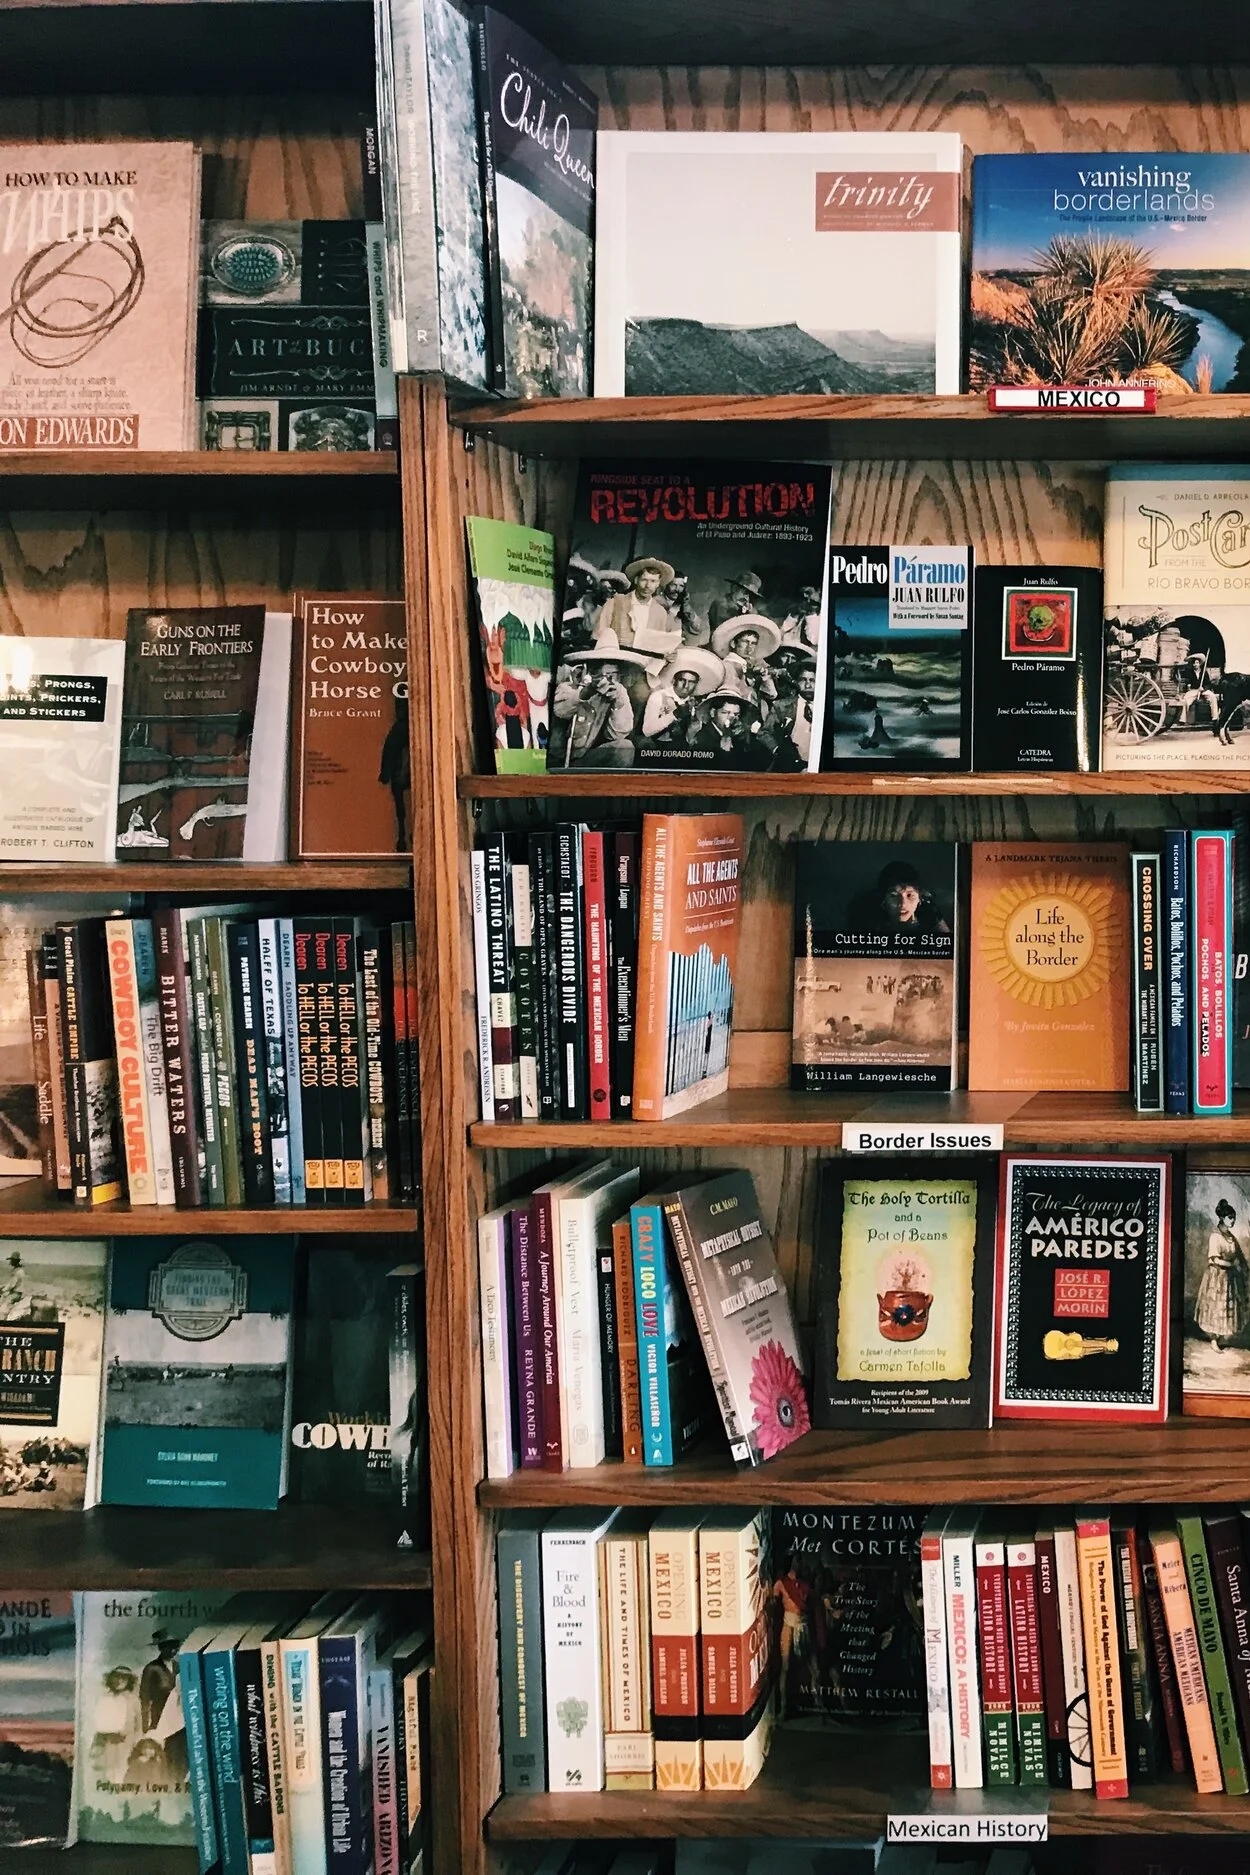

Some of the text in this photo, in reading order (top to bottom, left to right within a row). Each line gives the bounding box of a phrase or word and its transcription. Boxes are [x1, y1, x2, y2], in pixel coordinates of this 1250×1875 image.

[500, 72, 550, 150] Chili
[6, 172, 137, 187] HOW TO MAKE
[1077, 164, 1192, 190] vanishing
[824, 175, 934, 219] trinity
[1053, 189, 1215, 212] borderlands
[1038, 391, 1120, 407] MEXICO
[35, 417, 134, 444] EDWARDS
[591, 483, 815, 524] REVOLUTION
[832, 556, 887, 584] Pedro
[894, 555, 965, 584] Páramo
[1175, 577, 1218, 589] BRAVO
[892, 588, 964, 603] JUAN RULFO
[312, 608, 364, 625] How
[157, 625, 241, 639] GUNS ON THE
[311, 632, 408, 649] to Make
[140, 641, 253, 656] EARLY FRONTIERS
[311, 656, 406, 678] Cowboy
[310, 682, 381, 699] Horse
[30, 707, 86, 717] STICKERS
[309, 708, 382, 718] Bruce Grant
[693, 751, 714, 759] ROMO
[1035, 909, 1065, 925] Life
[835, 934, 951, 947] Cutting for Sign
[1016, 931, 1084, 945] along the
[1026, 949, 1078, 966] Border
[108, 940, 147, 1174] COWBOY CULTURE
[161, 975, 186, 1134] BITTER WATERS
[806, 1073, 936, 1083] William Langewiesche
[860, 1133, 991, 1148] Border Issues
[850, 1192, 970, 1205] The Holy Tortilla
[1026, 1193, 1143, 1216] The Legacy of
[895, 1214, 910, 1222] and
[1026, 1213, 1144, 1237] AMÉRICO
[867, 1228, 948, 1243] Pot of Beans
[1031, 1239, 1138, 1259] PAREDES
[1060, 1271, 1105, 1284] JOSÉ R.
[1061, 1285, 1104, 1298] LÓPEZ
[1057, 1301, 1105, 1313] MORÍN
[859, 1360, 945, 1372] Carmen Tafolla
[557, 1572, 580, 1582] Fire
[563, 1584, 574, 1595] &
[104, 1600, 199, 1617] the fourth
[552, 1596, 585, 1608] Blood
[888, 1820, 1046, 1841] Mexican History
